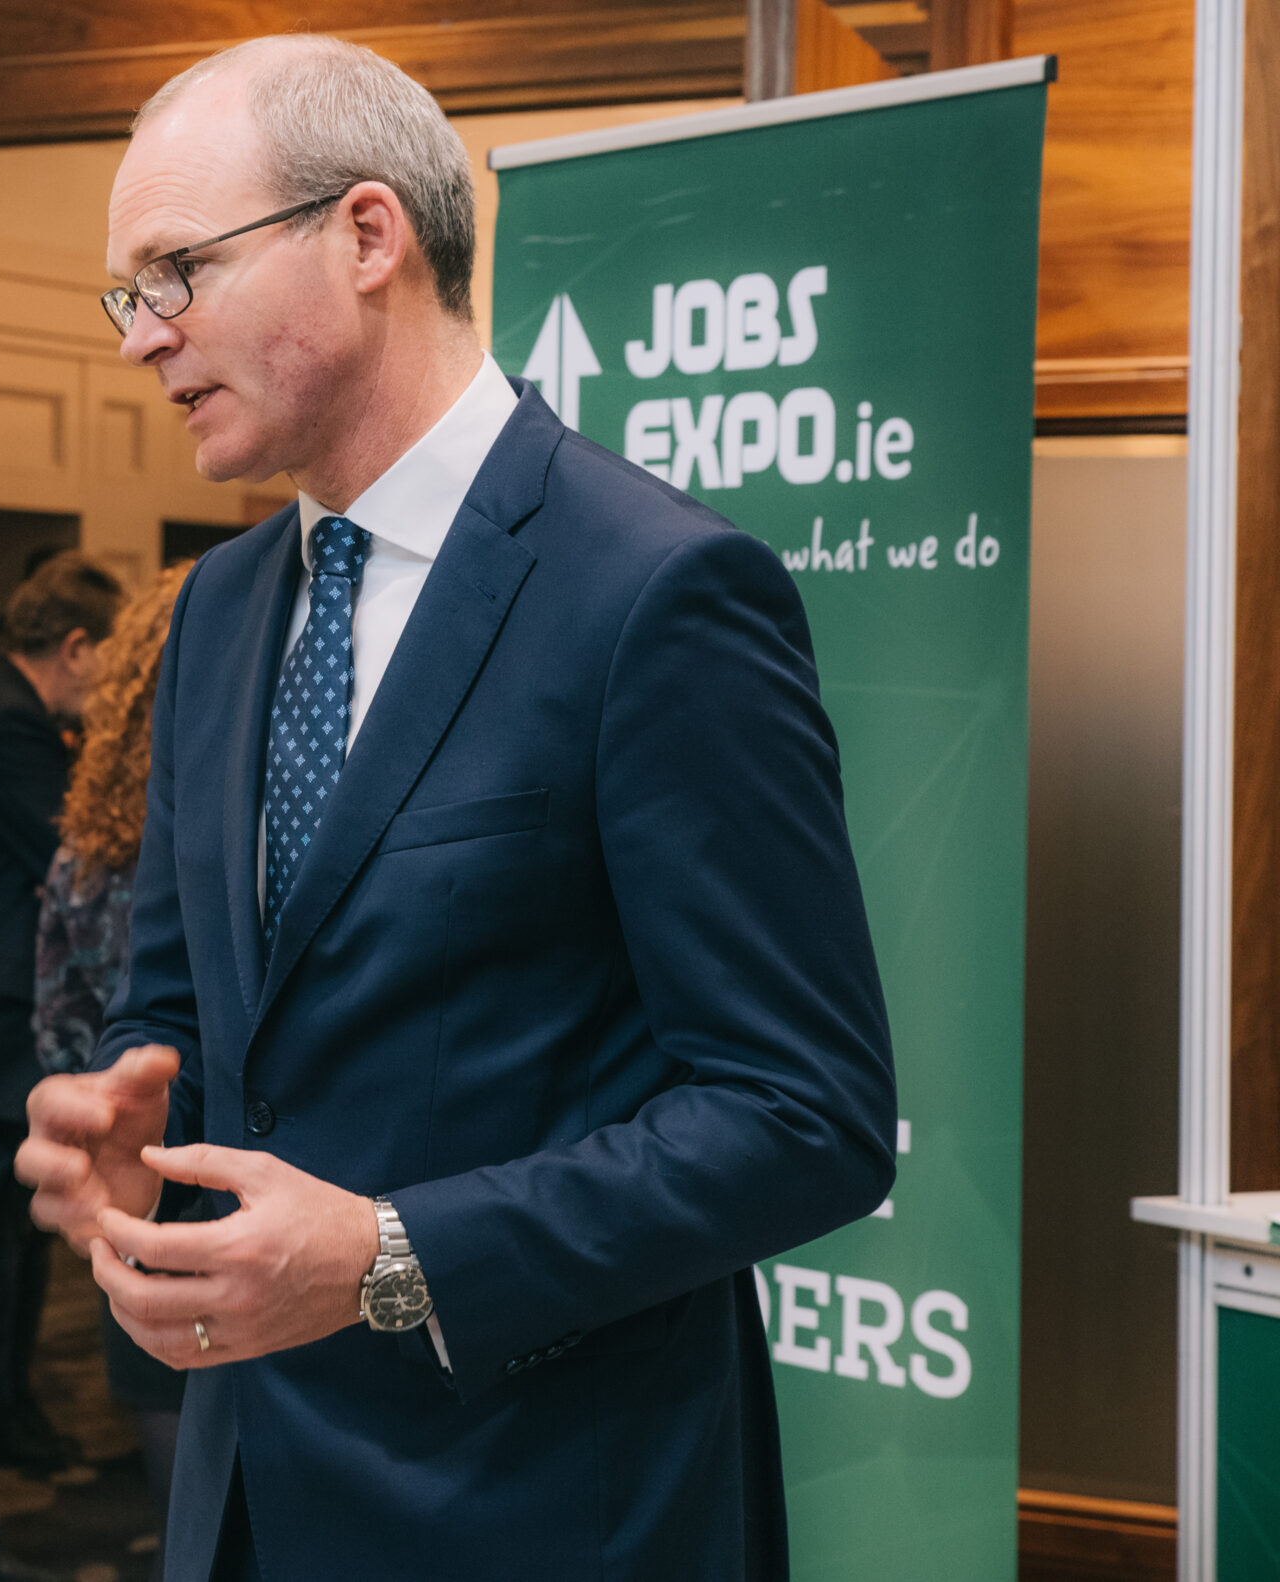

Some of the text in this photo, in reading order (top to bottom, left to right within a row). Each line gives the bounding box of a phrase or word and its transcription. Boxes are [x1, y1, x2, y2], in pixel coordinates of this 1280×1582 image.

[625, 265, 828, 379] JOBS
[625, 387, 915, 490] EXPO.ie
[781, 512, 1001, 573] what we do
[753, 1262, 972, 1399] ERS
